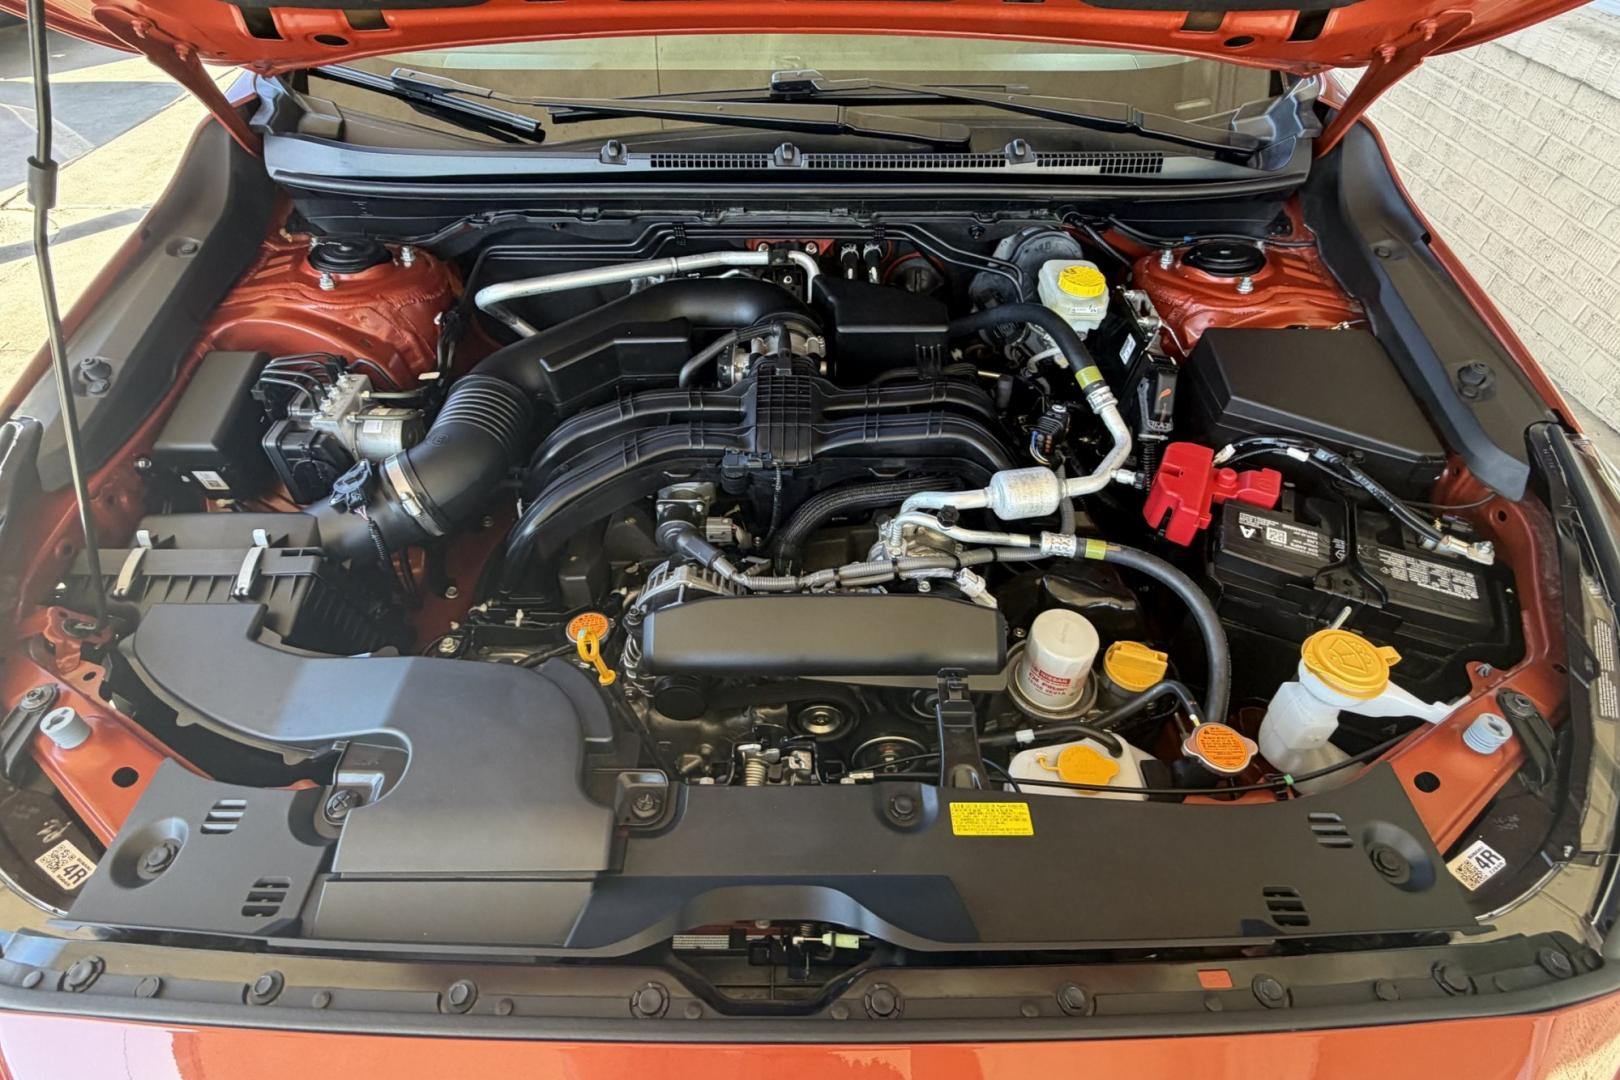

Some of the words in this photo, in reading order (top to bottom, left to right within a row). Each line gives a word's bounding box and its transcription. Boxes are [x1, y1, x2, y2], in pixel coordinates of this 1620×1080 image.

[1240, 525, 1256, 538] A
[1475, 849, 1501, 869] 4R
[63, 863, 88, 885] 4R
